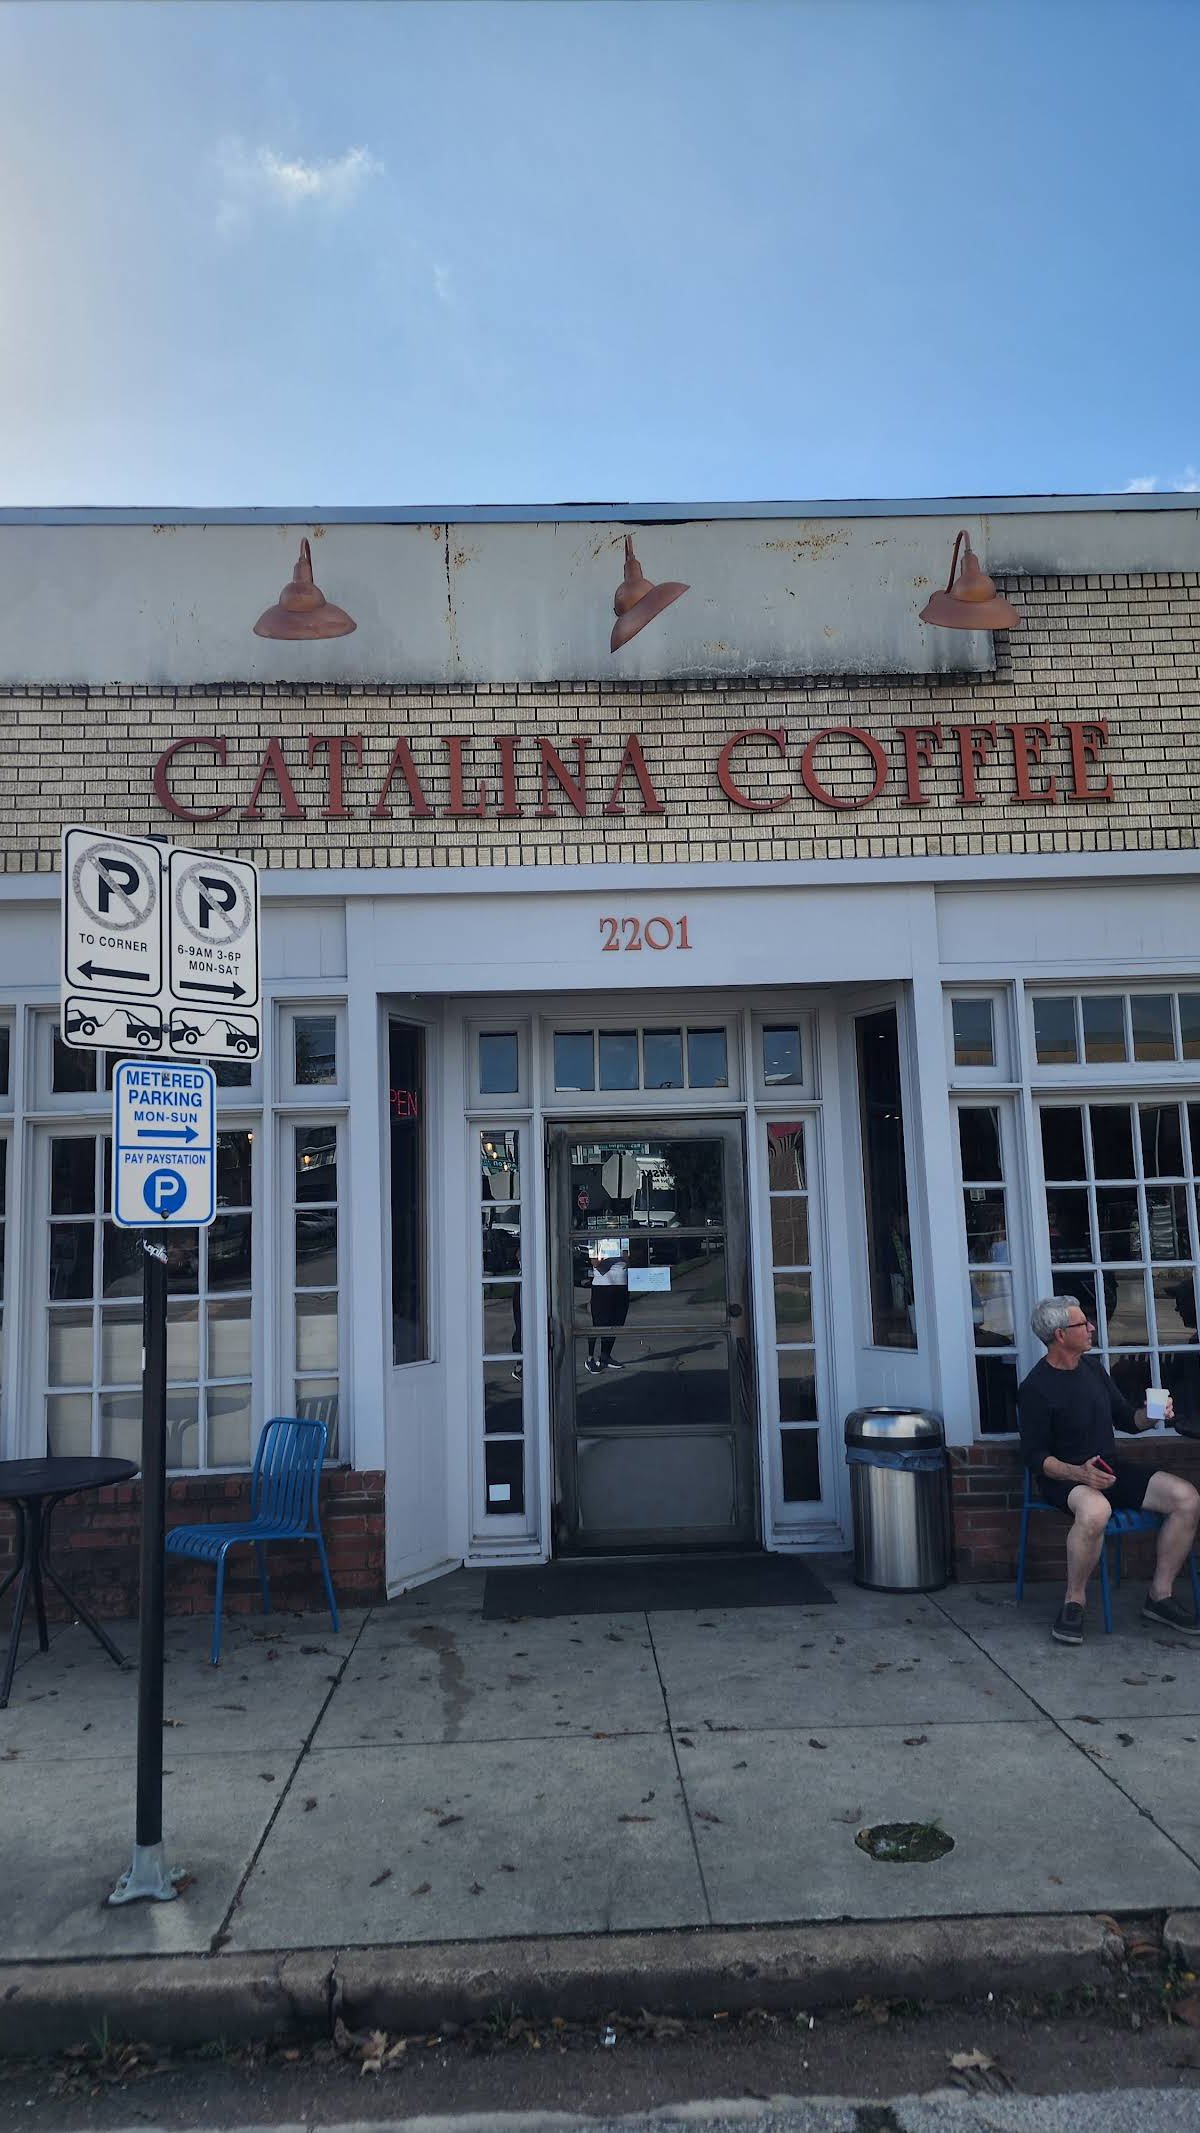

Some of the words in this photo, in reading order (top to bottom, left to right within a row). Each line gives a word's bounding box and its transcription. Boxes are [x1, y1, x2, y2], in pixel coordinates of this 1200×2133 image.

[153, 732, 666, 822] CATALINA
[716, 718, 1115, 811] COFFEE
[79, 933, 95, 944] TO
[99, 936, 148, 952] CORNER
[599, 915, 693, 951] 2201
[177, 945, 213, 959] 6-9AM
[217, 950, 242, 962] 3-6P
[189, 960, 240, 976] MON-SAT
[126, 1070, 205, 1090] METERED
[128, 1089, 203, 1107] PARKING
[389, 1088, 418, 1119] PEN
[134, 1111, 198, 1123] MON-SUN
[124, 1153, 144, 1164] PAY
[146, 1154, 206, 1165] PAYSTATION
[154, 1175, 179, 1208] P
